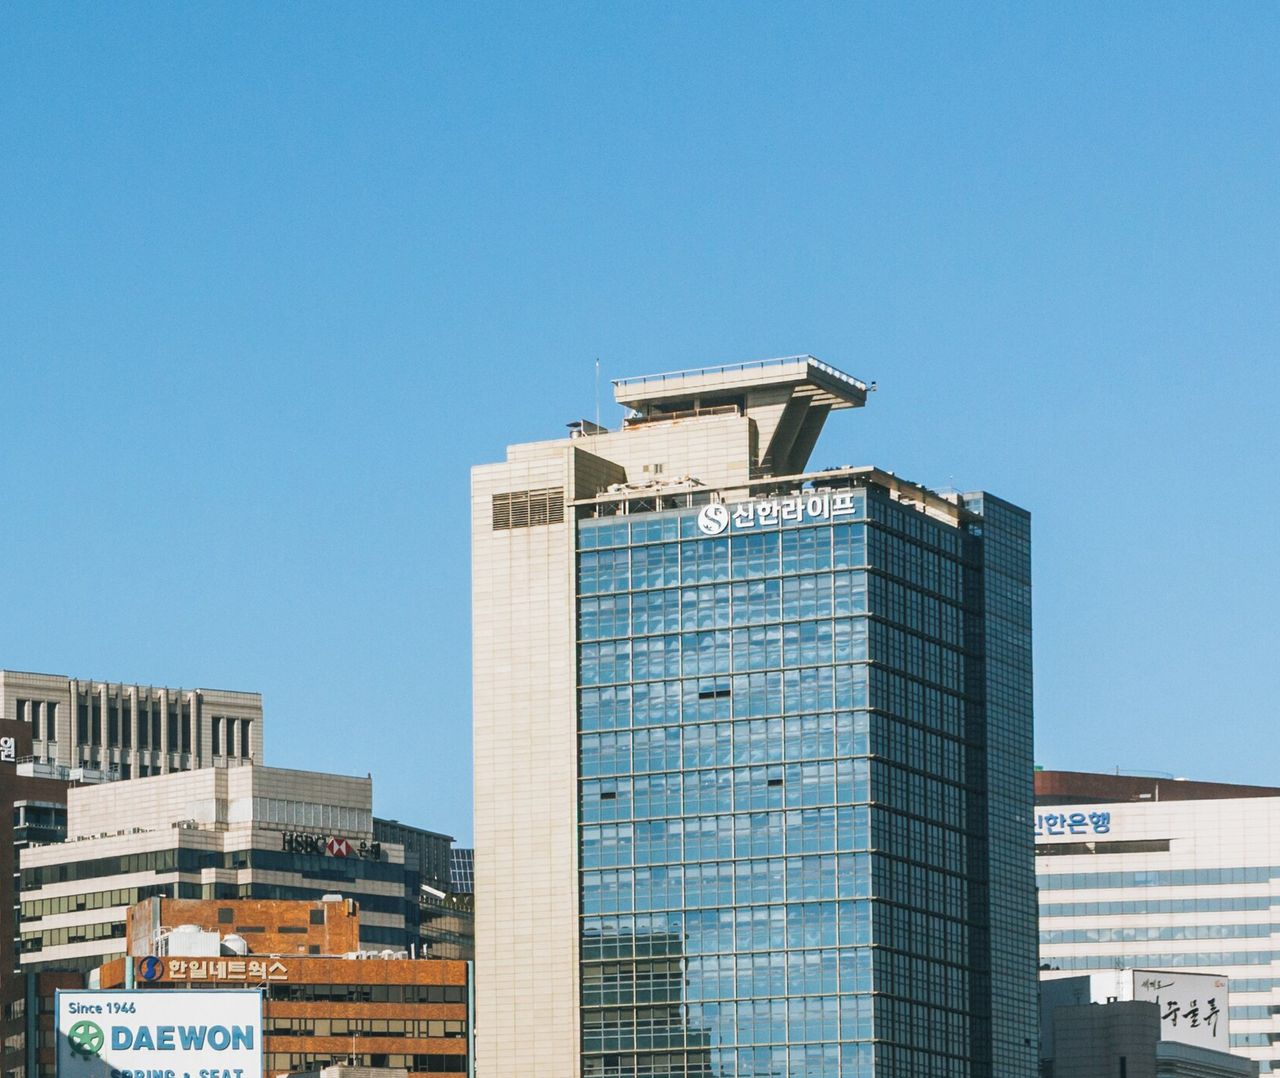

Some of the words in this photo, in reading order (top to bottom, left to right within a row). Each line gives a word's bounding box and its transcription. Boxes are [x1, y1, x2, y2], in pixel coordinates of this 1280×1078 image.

[732, 493, 856, 527] 신한라이프
[169, 960, 289, 980] 한일네트웍스
[68, 1002, 102, 1014] Since
[106, 1002, 136, 1014] 1946
[111, 1025, 254, 1051] DAEWON
